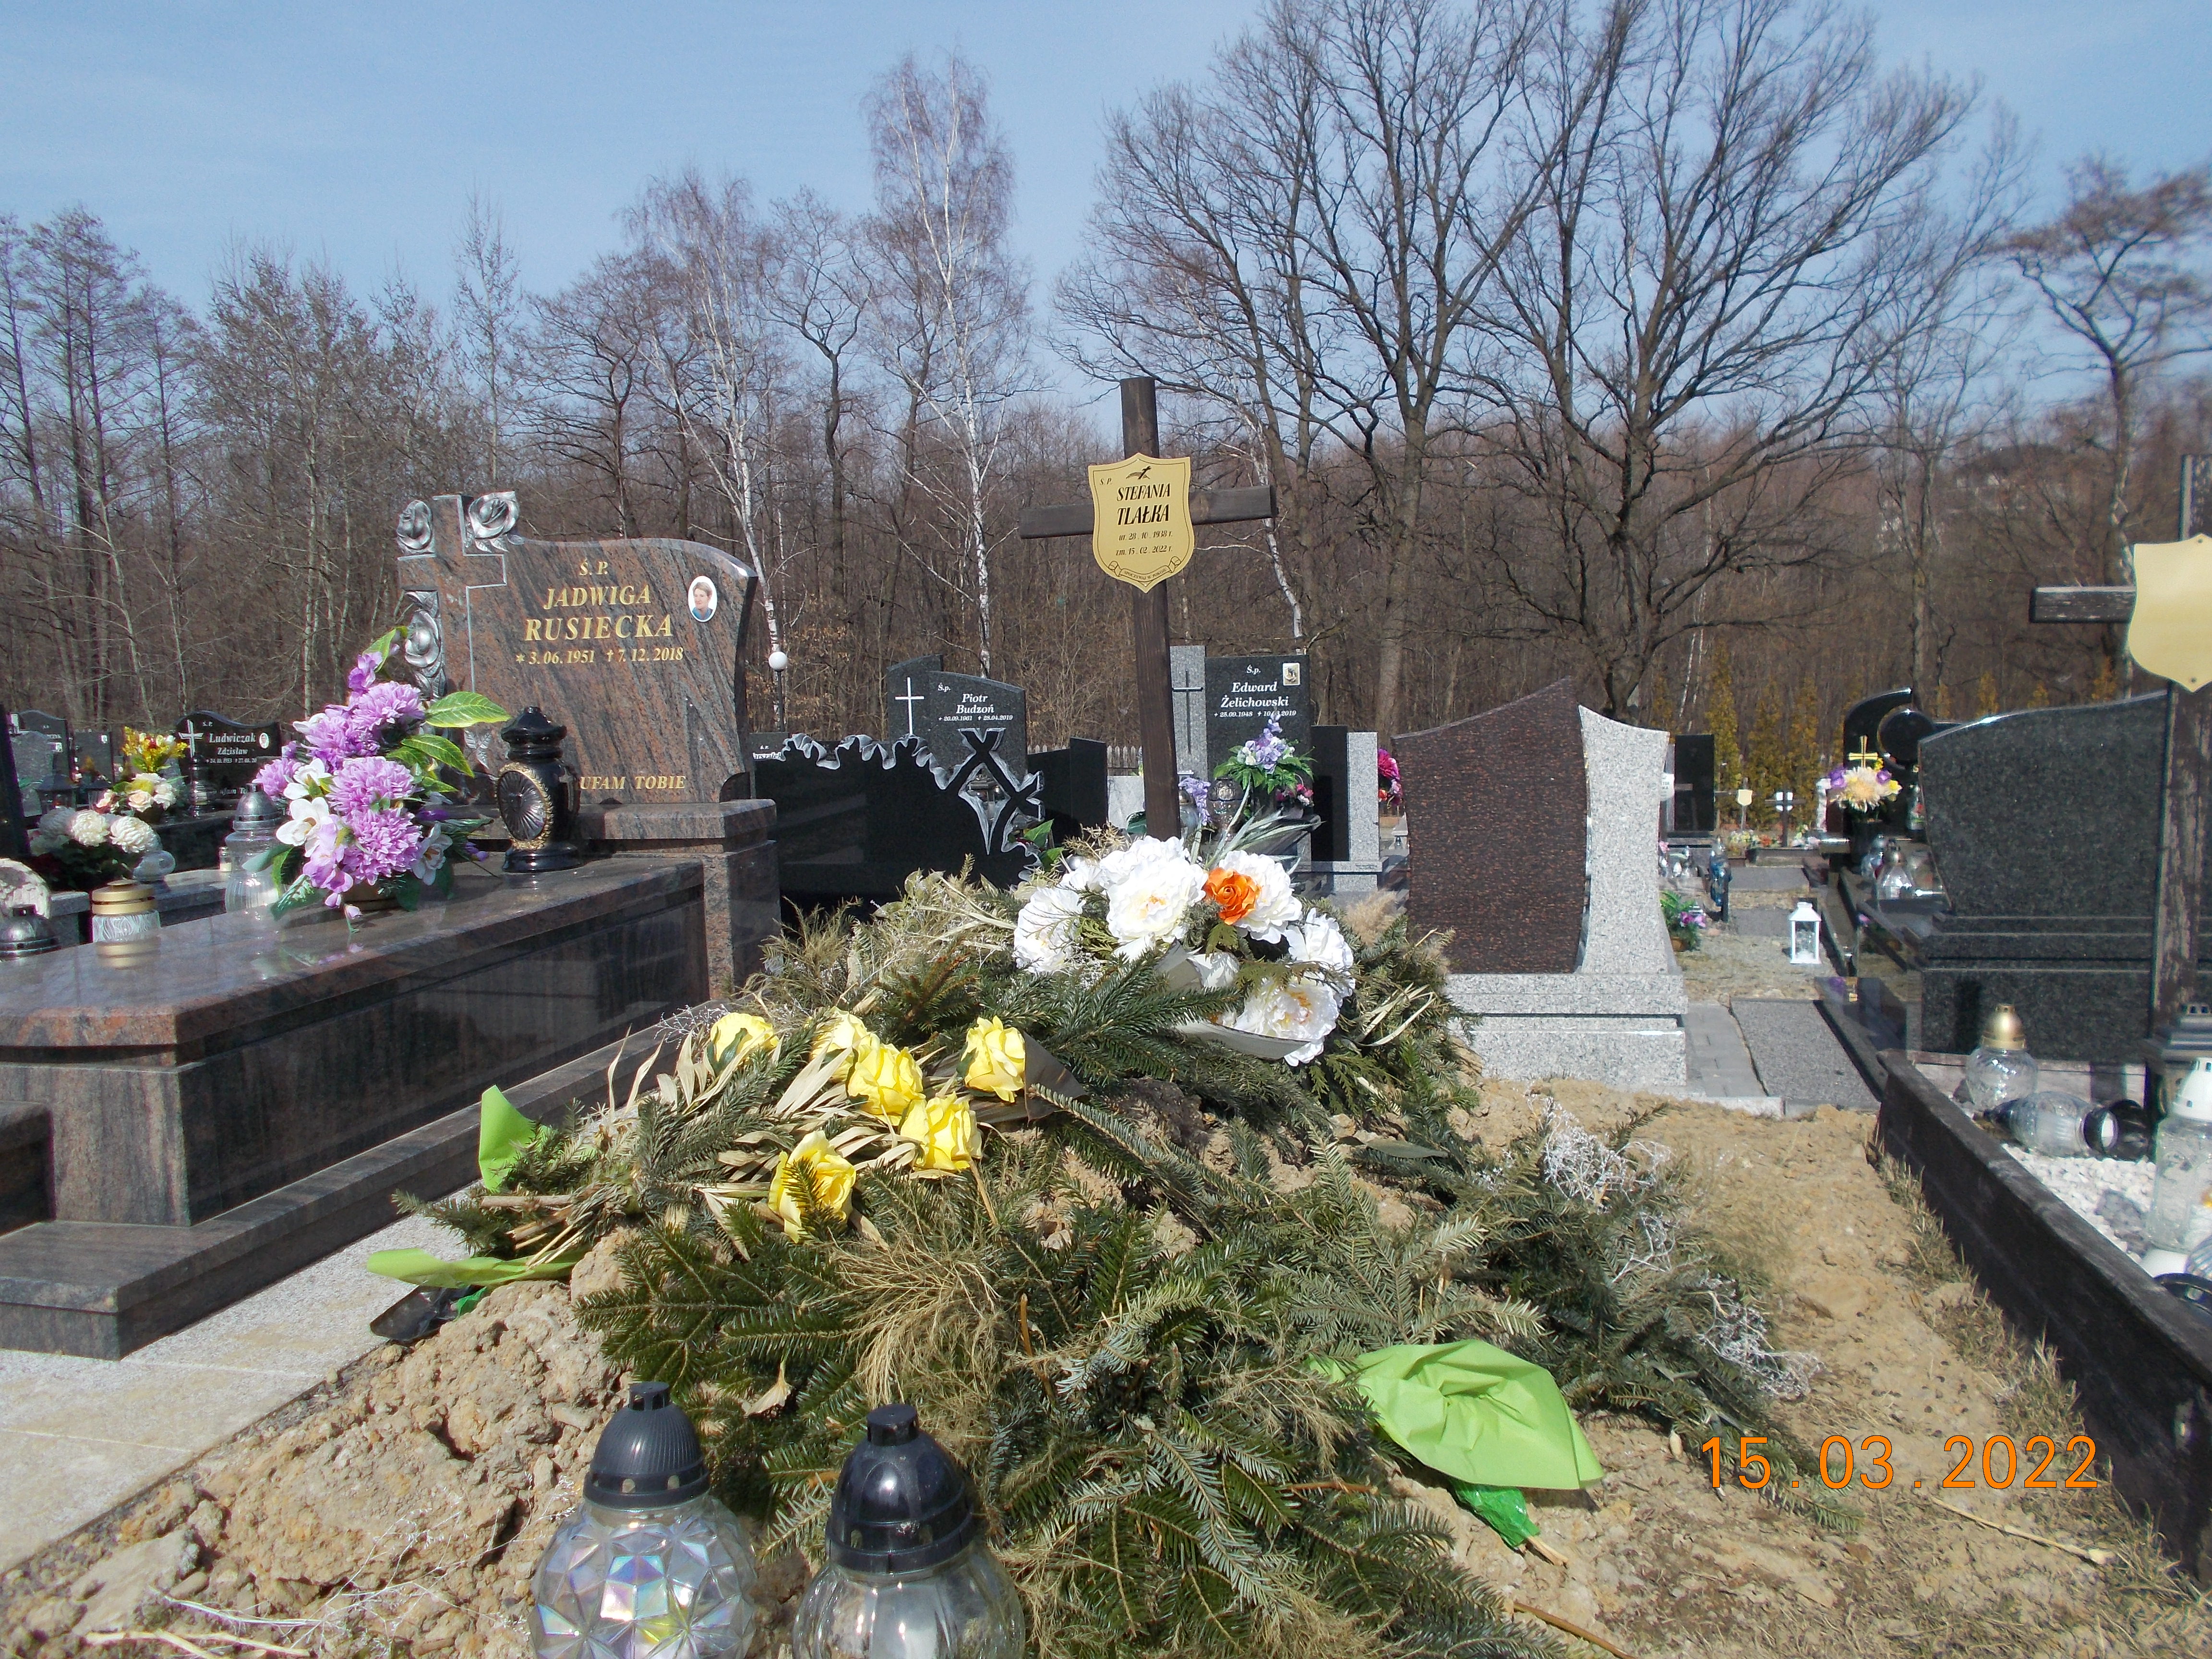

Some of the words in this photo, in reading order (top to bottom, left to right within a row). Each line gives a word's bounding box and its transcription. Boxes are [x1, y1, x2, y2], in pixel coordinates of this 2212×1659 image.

[1117, 483, 1170, 502] STEFANIA
[1117, 504, 1169, 525] TLAŁKA
[598, 561, 608, 575] P.
[543, 584, 651, 610] JADWIGA
[524, 614, 673, 641] RUSIECKA
[566, 650, 595, 663] 1951
[653, 647, 684, 661] 2018
[1231, 682, 1277, 693] Edward
[962, 694, 988, 703] Piotr
[1220, 695, 1289, 708] Żelichowski
[956, 704, 994, 714] Budzoń
[209, 733, 256, 743] Ludwiczak
[217, 747, 248, 755] Zdzisław
[580, 776, 626, 790] UFAM
[635, 776, 686, 789] TOBIE
